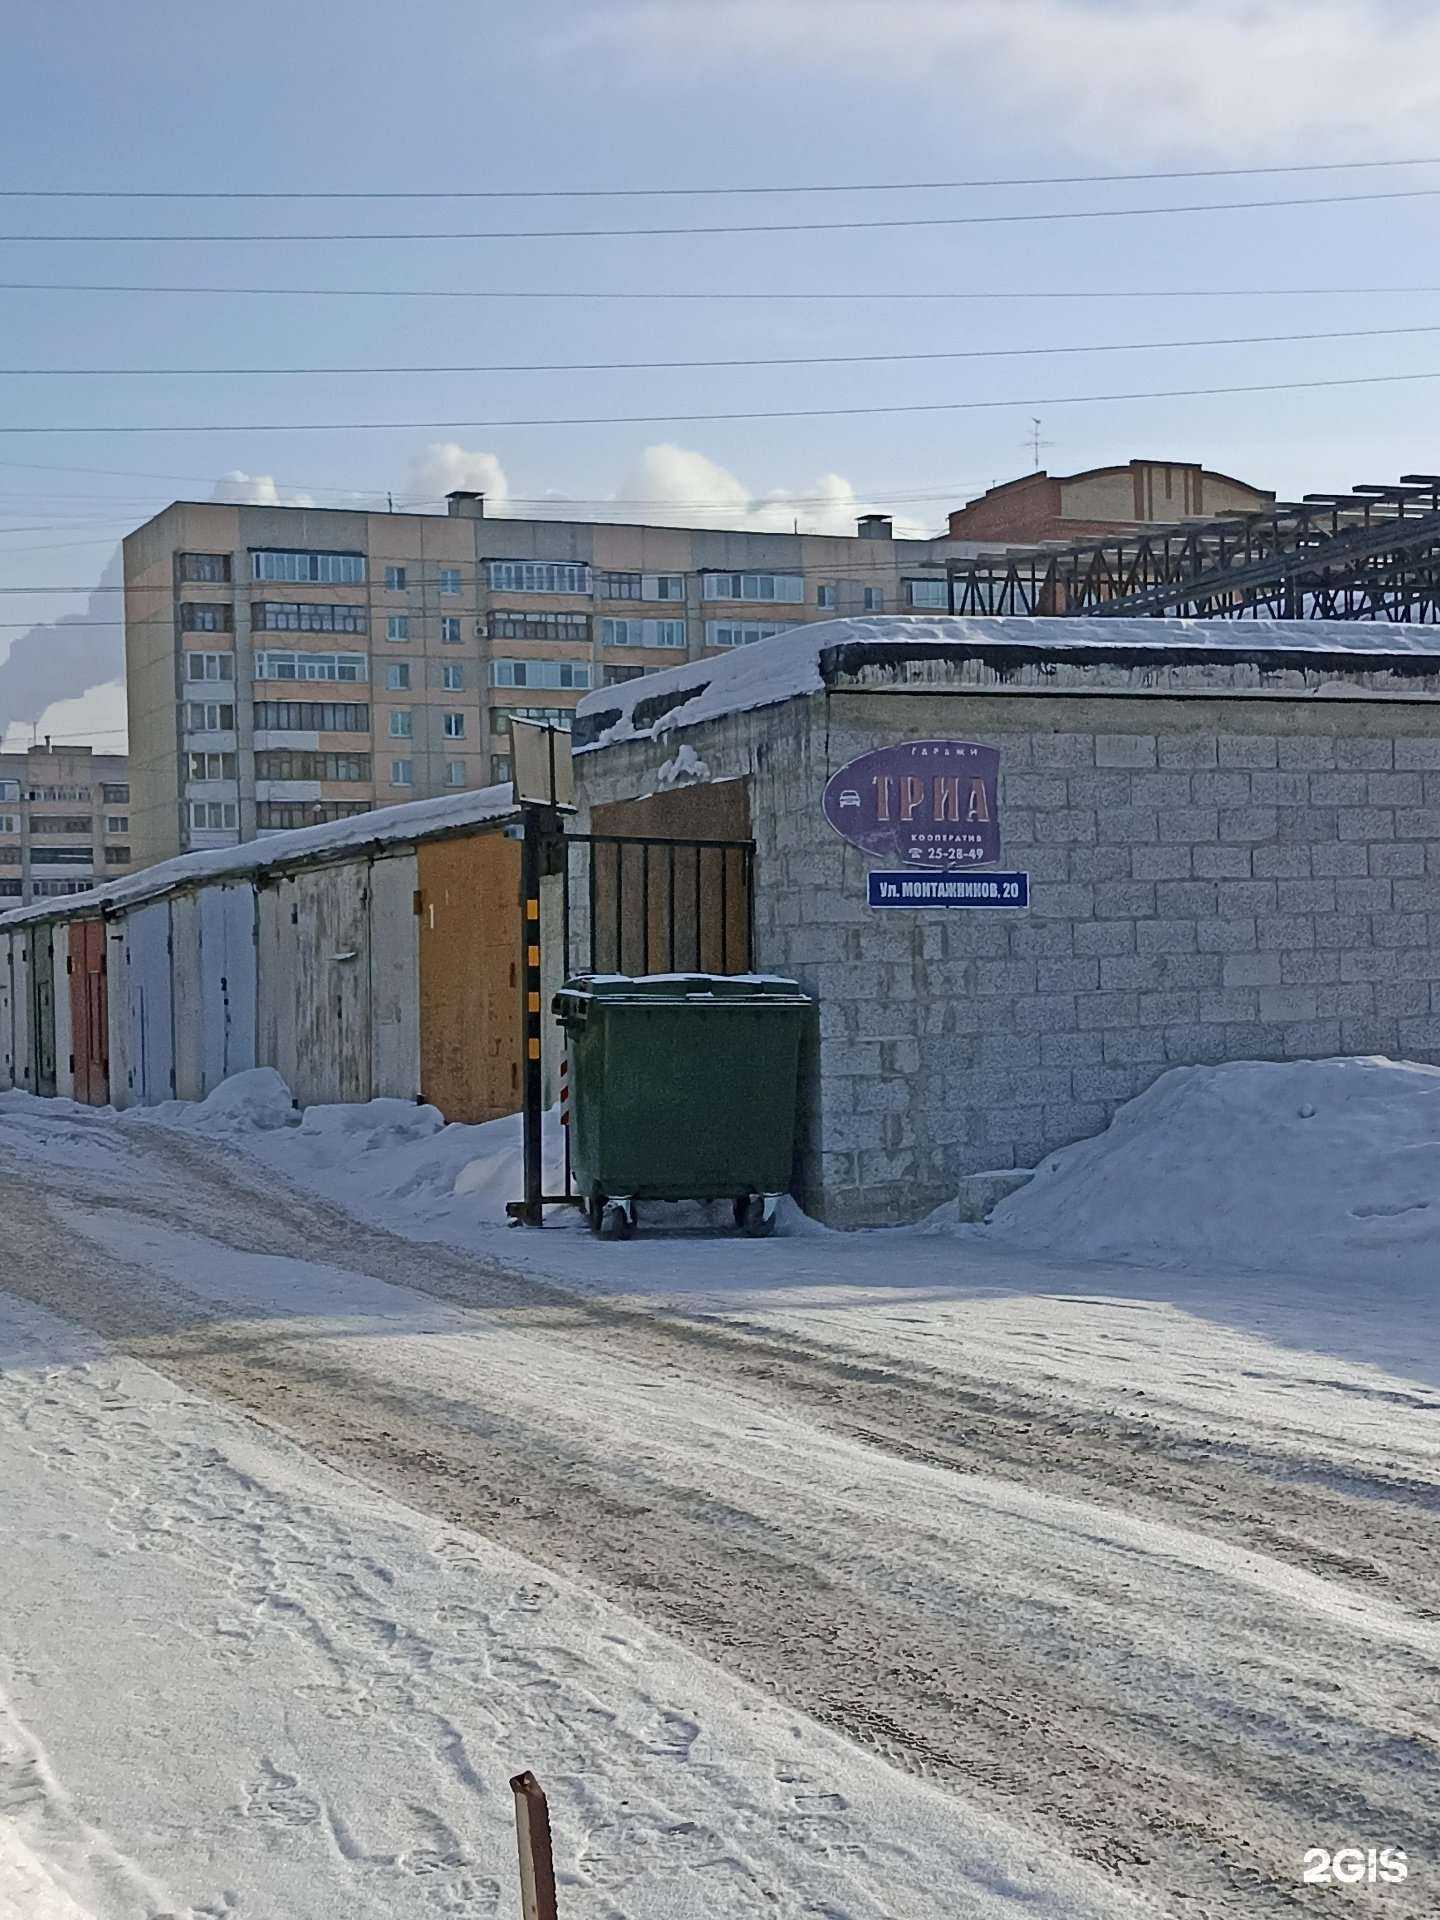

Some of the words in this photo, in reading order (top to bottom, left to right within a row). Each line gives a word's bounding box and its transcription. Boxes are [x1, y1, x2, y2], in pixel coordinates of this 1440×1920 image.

[911, 746, 978, 755] ГАРАЖИ
[871, 775, 990, 822] ТРИА
[911, 834, 982, 842] КООПЕРАТИВ
[928, 847, 984, 859] 25-28-49
[880, 882, 900, 898] Ул.
[901, 882, 1000, 899] МОНТАЖНИКОВ,
[1003, 882, 1019, 898] 20
